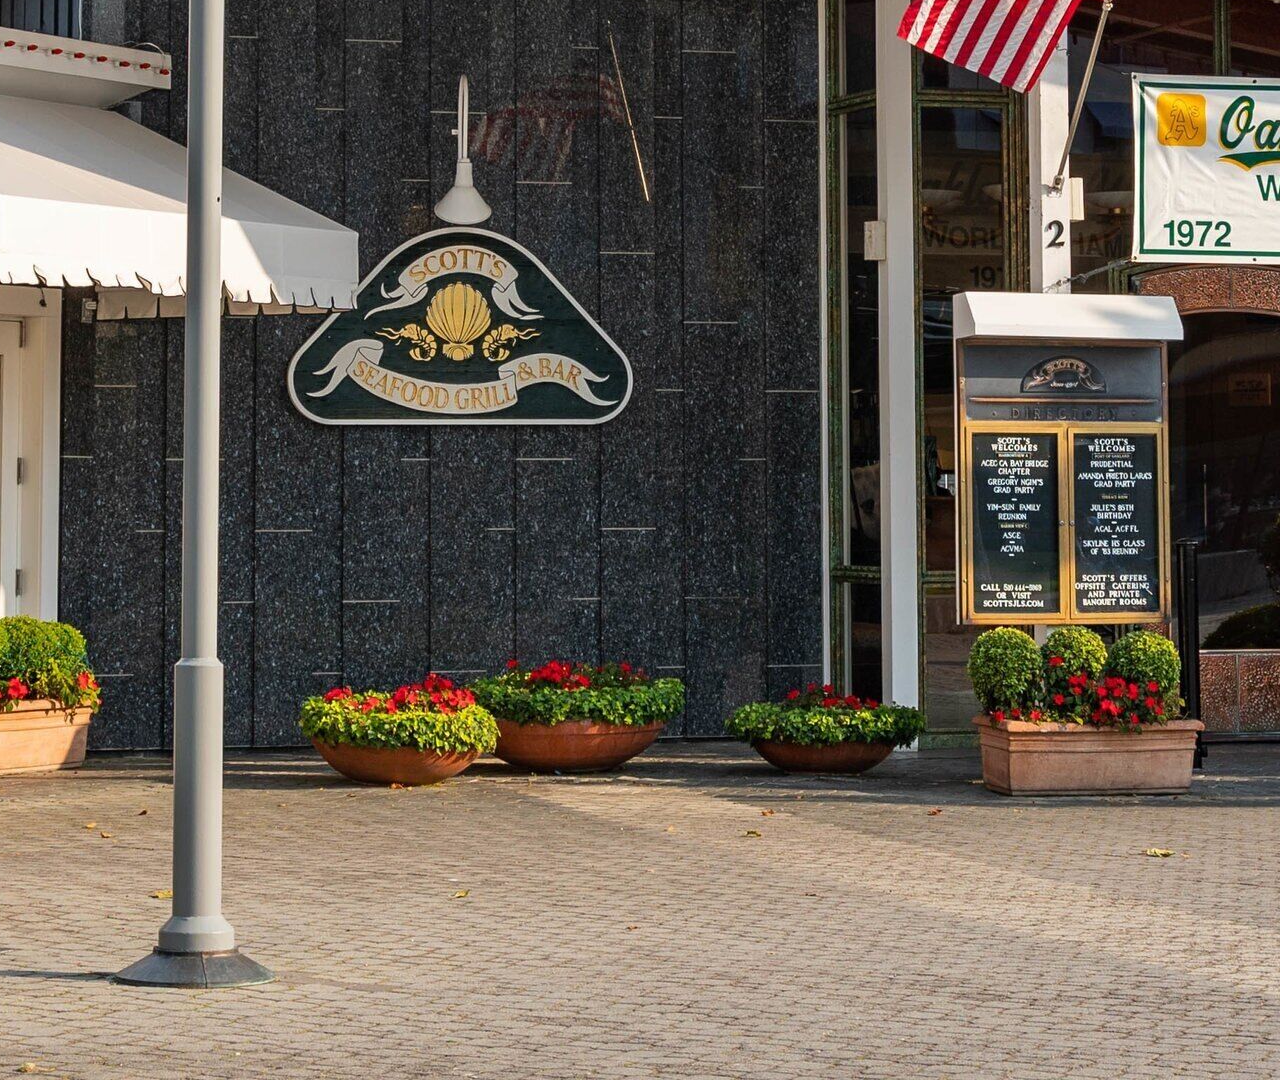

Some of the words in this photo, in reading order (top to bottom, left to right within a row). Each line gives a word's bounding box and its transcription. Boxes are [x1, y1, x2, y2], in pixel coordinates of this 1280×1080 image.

[1045, 220, 1065, 248] 2
[1163, 220, 1231, 247] 1972
[408, 248, 507, 283] SCOTT'S
[352, 360, 450, 408] SEAFOOD
[454, 383, 516, 410] GRILL
[516, 361, 538, 381] &
[538, 357, 582, 391] BAR
[1010, 407, 1120, 420] DIRECTORY
[997, 437, 1030, 445] SCOTT'S
[1090, 460, 1133, 468] PRUDENTIAL
[987, 478, 1019, 486] GREGORY
[1082, 574, 1115, 582] SCOTT'S
[980, 583, 1000, 591] CALL
[1074, 582, 1106, 590] OFFSITE
[1112, 582, 1150, 590] CATERING
[1087, 590, 1105, 598] AND
[1109, 590, 1140, 598] PRIVATE
[1082, 598, 1117, 606] BANQUET
